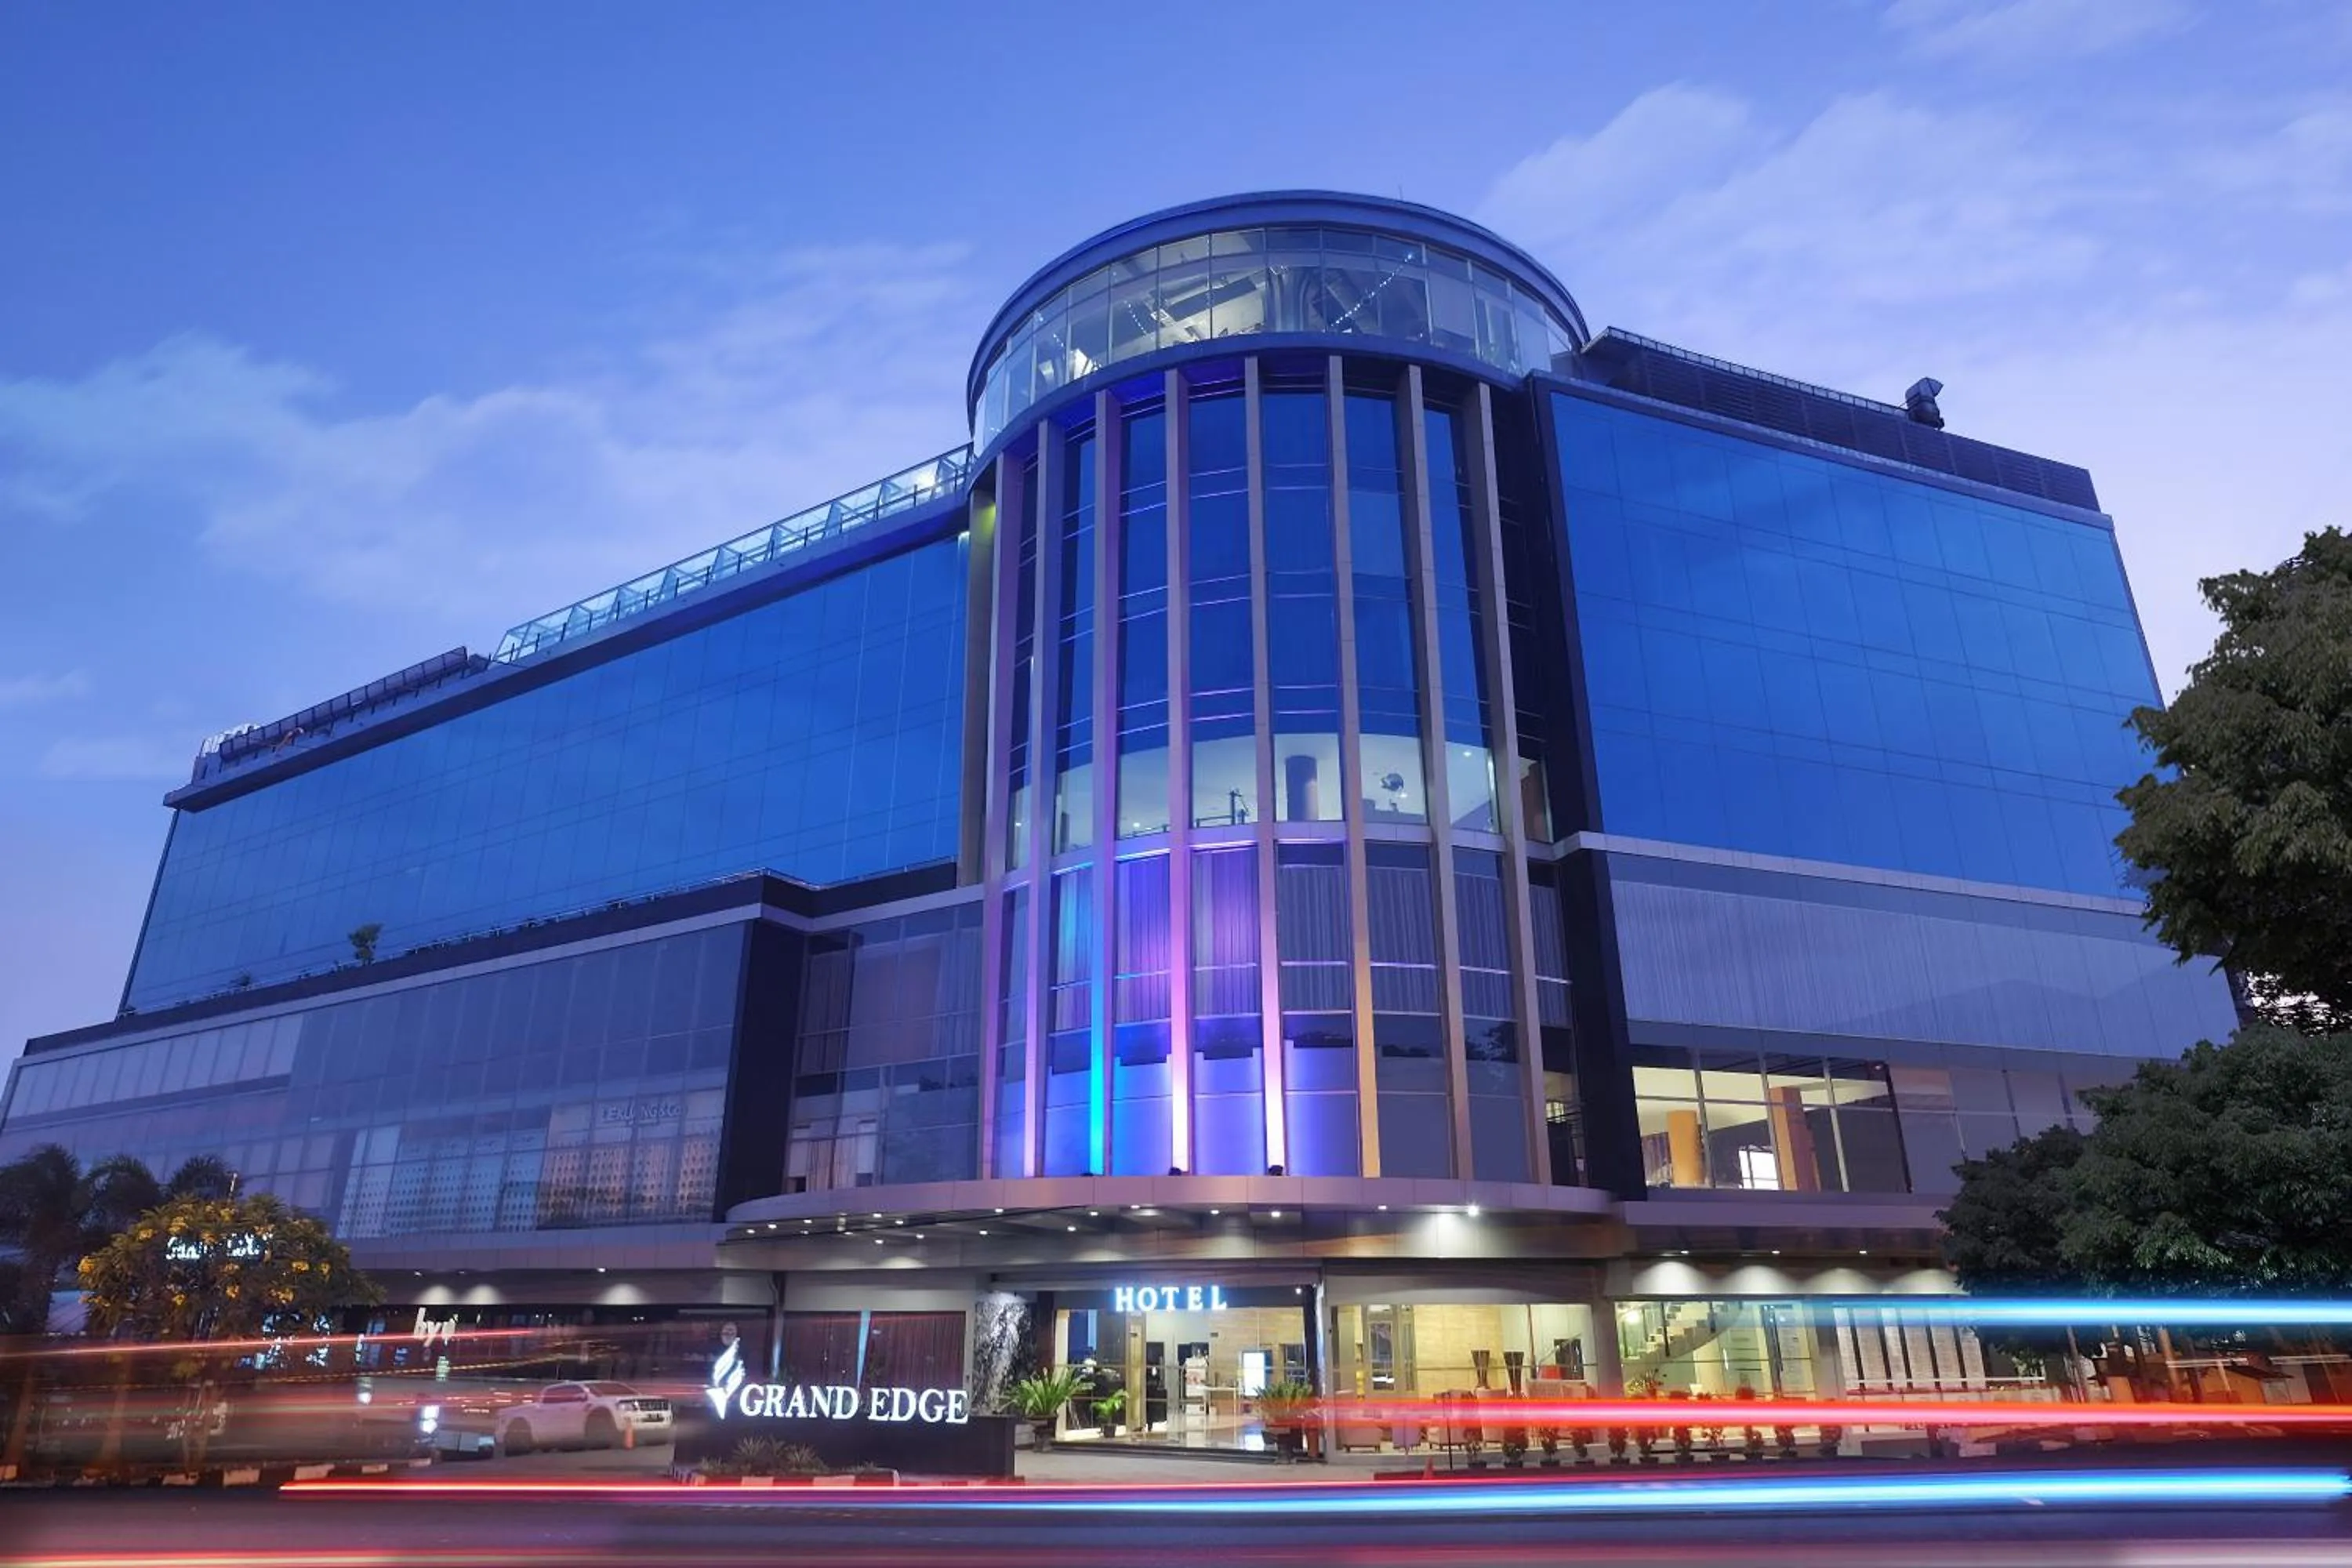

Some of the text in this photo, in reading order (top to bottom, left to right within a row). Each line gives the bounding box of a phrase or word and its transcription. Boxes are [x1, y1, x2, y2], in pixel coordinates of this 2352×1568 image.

[1115, 1286, 1228, 1312] HOTEL
[739, 1383, 968, 1424] GRAND EDGE
